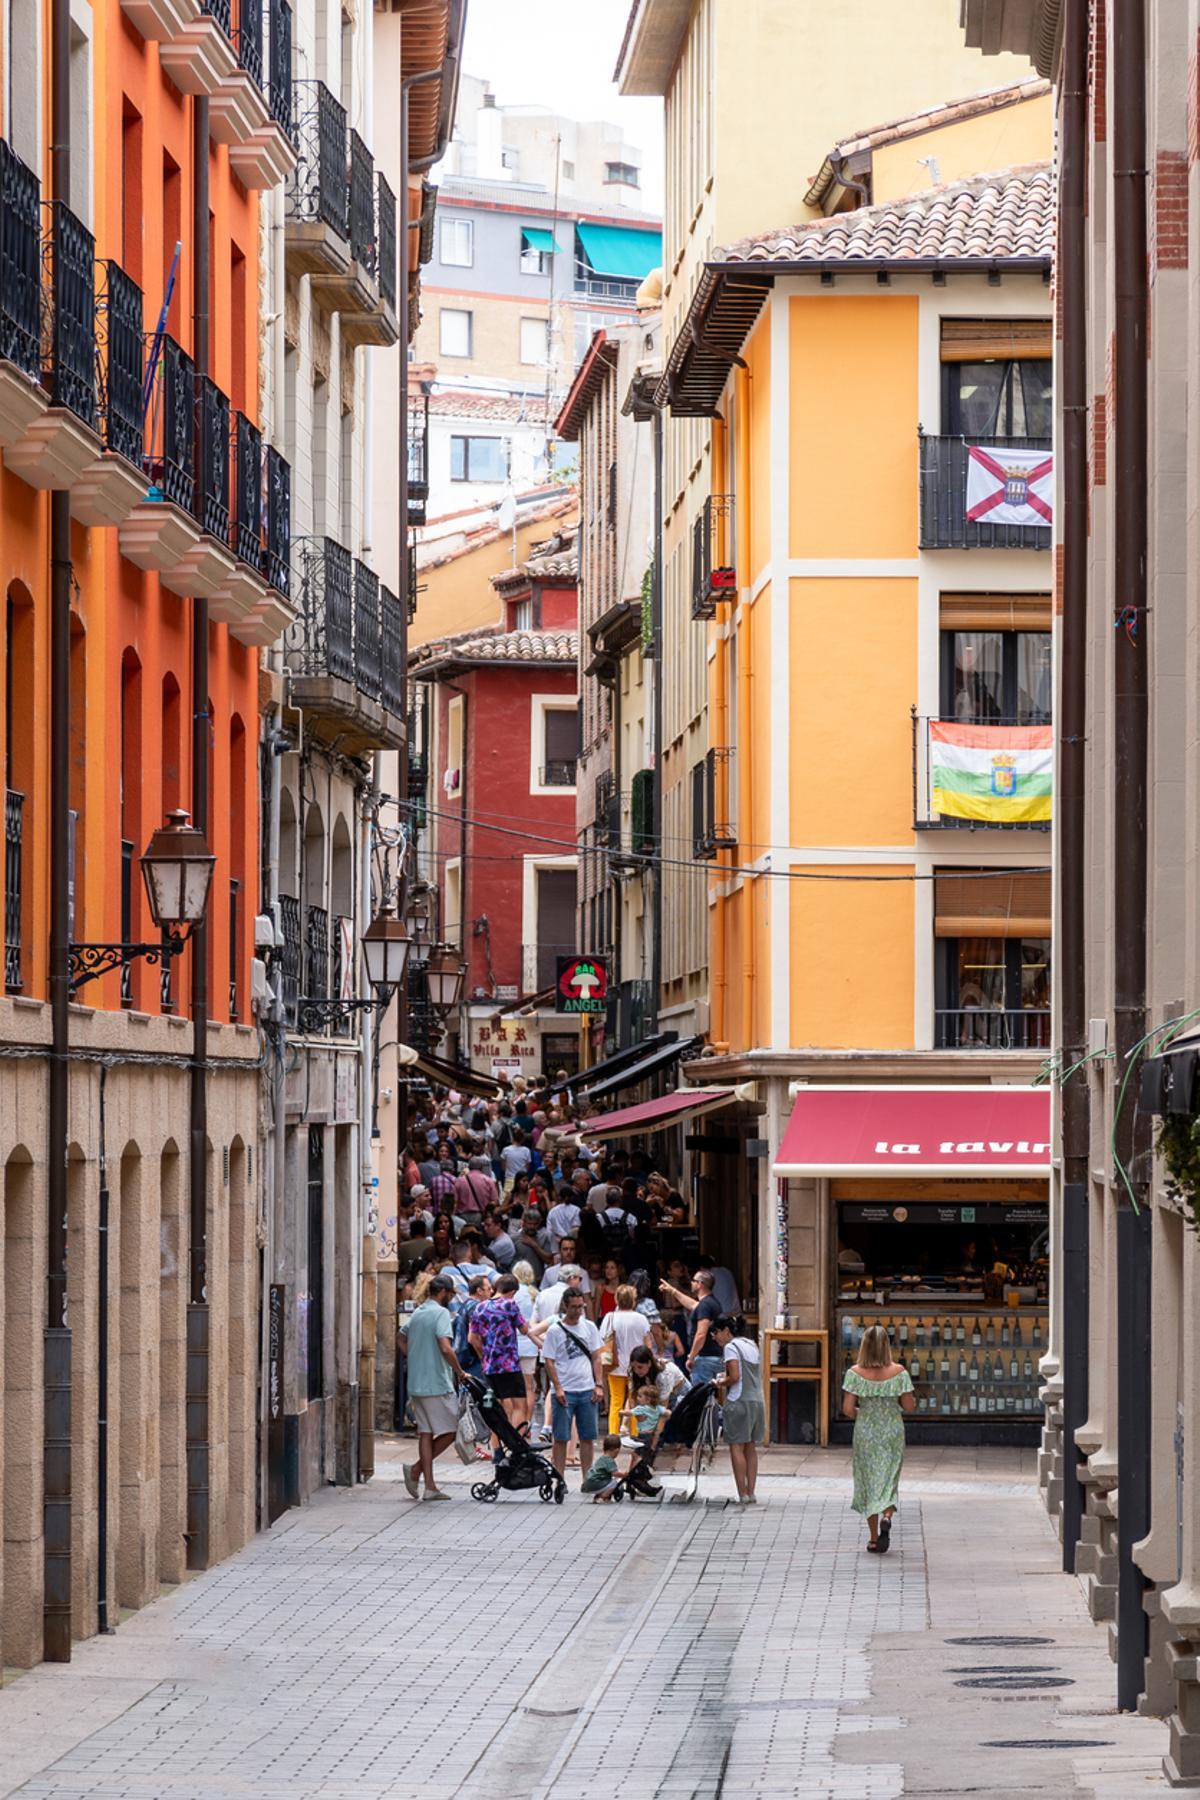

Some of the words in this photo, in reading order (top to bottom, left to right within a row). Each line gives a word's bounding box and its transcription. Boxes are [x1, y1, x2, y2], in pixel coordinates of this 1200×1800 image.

[564, 999, 607, 1011] ANGEL
[473, 1044, 500, 1056] Villa
[510, 1044, 535, 1056] Rica
[875, 1142, 921, 1154] la
